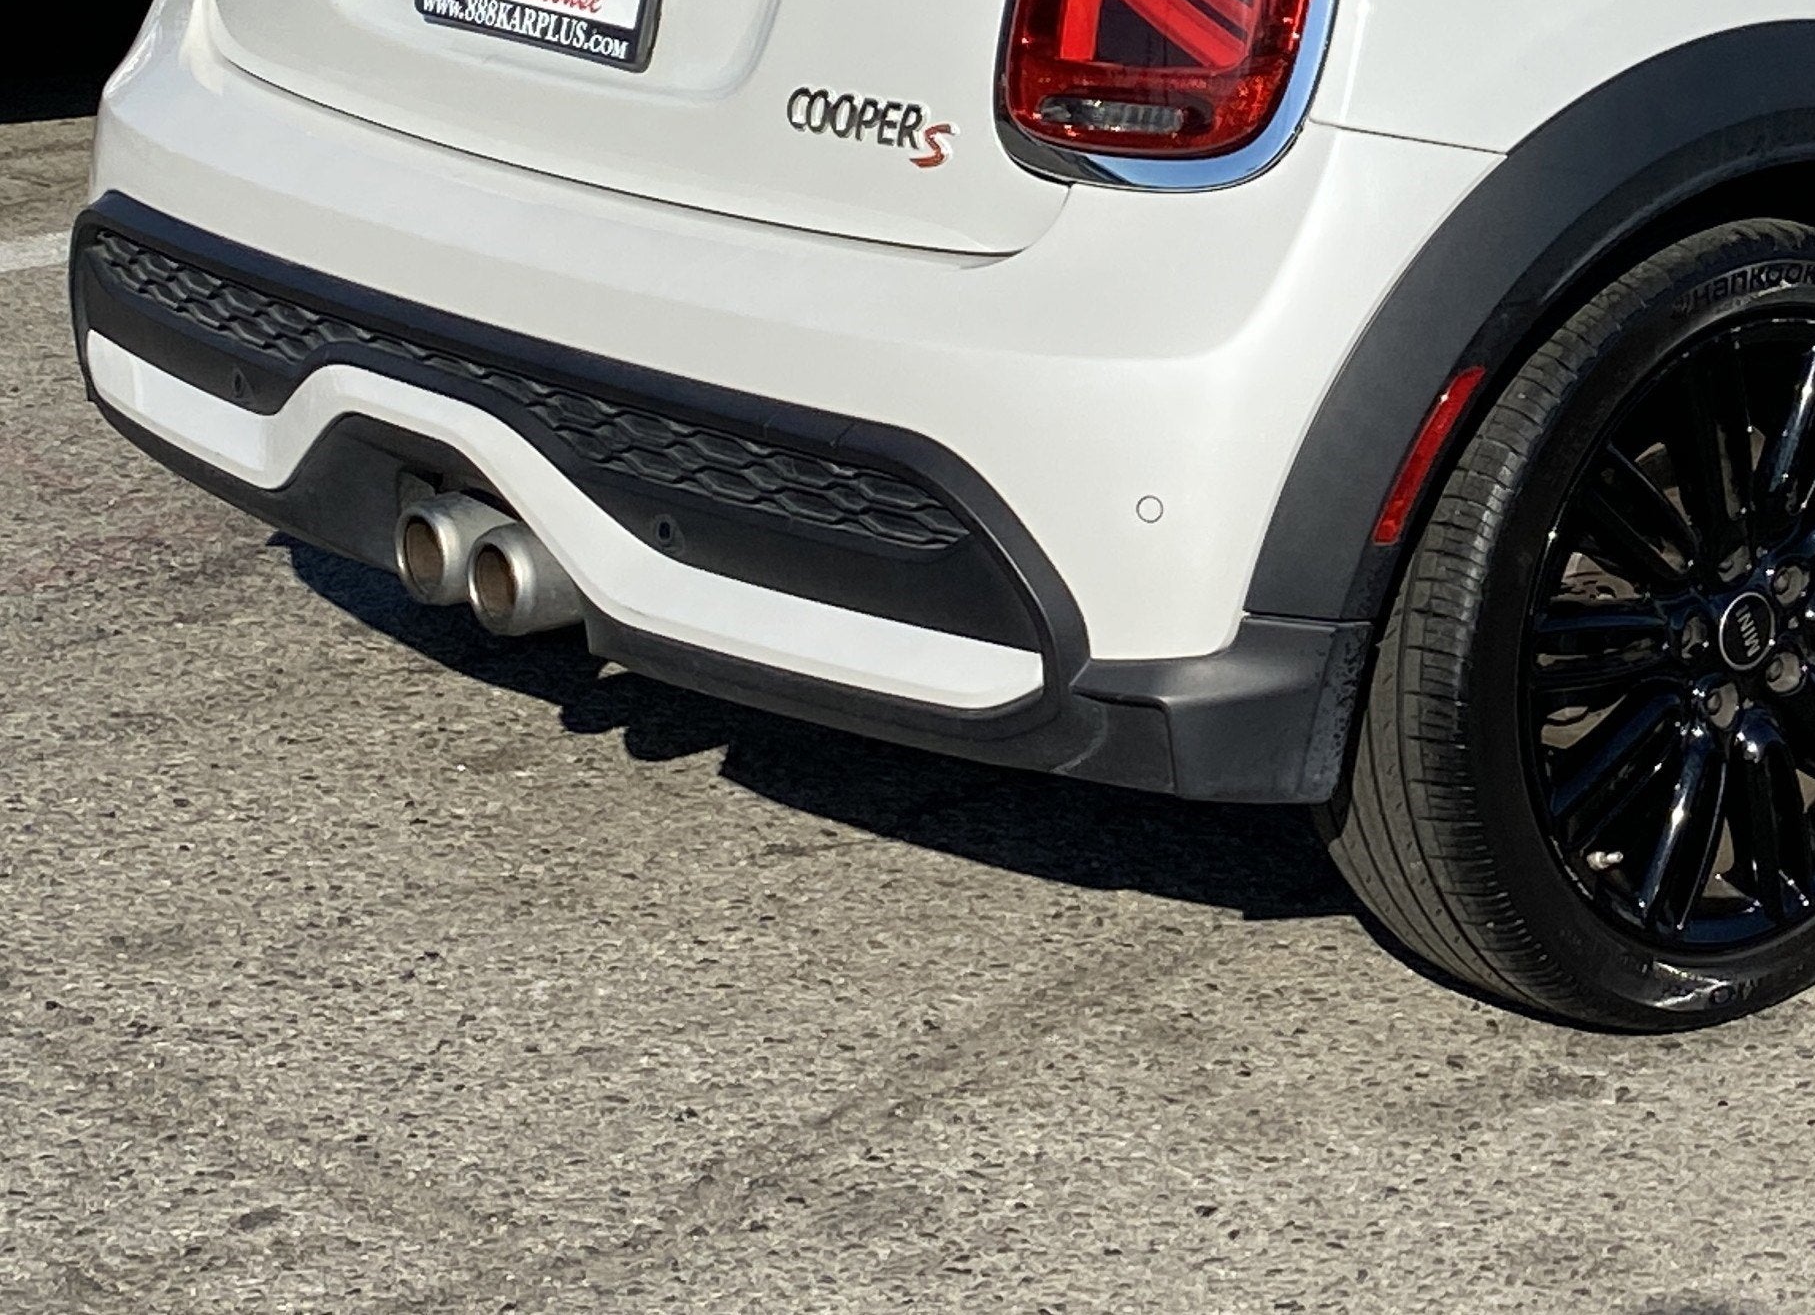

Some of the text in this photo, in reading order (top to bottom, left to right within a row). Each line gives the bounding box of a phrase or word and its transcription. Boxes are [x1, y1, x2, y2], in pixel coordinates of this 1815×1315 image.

[787, 87, 955, 169] COOPER S
[1735, 604, 1761, 658] MINI
